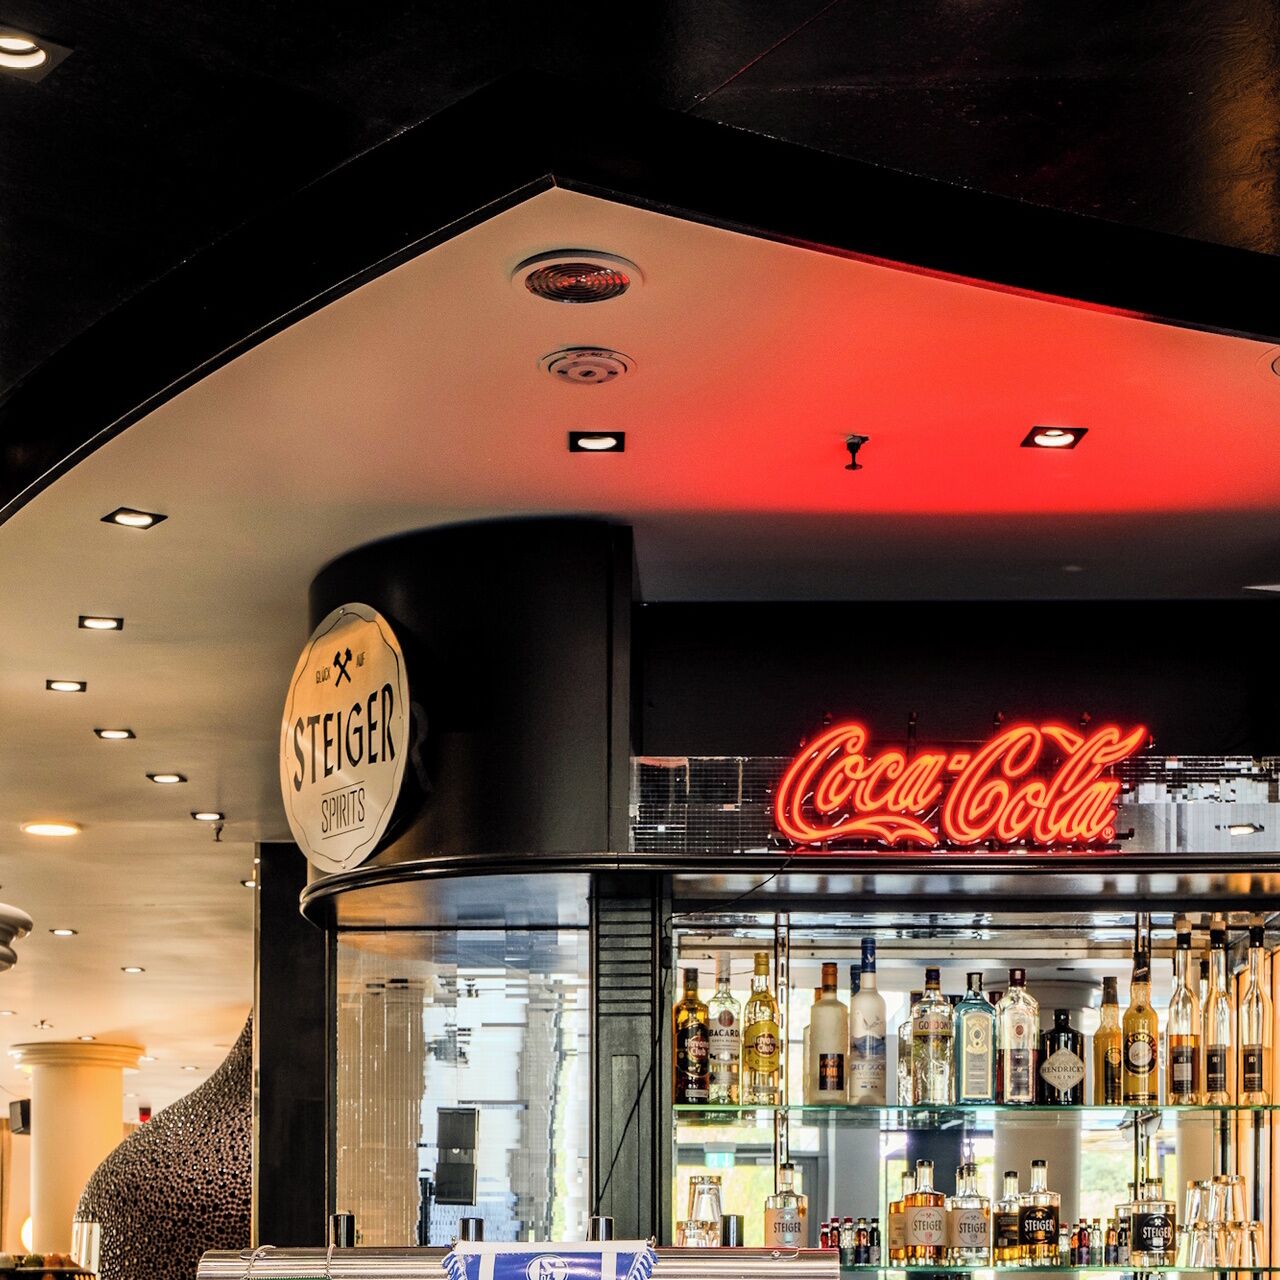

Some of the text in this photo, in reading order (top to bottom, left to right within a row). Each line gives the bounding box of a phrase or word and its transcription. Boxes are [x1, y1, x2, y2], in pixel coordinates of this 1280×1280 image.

[294, 682, 396, 792] STEIGER
[775, 724, 1147, 846] Coca-Cola
[321, 788, 366, 833] SPIRITS
[709, 1029, 739, 1038] BACARD
[773, 1222, 801, 1233] STEIGER
[914, 1220, 942, 1232] STEIGER
[959, 1222, 987, 1233] STEIGER
[1024, 1219, 1054, 1232] STEIGER
[1142, 1226, 1171, 1239] STEIGER
